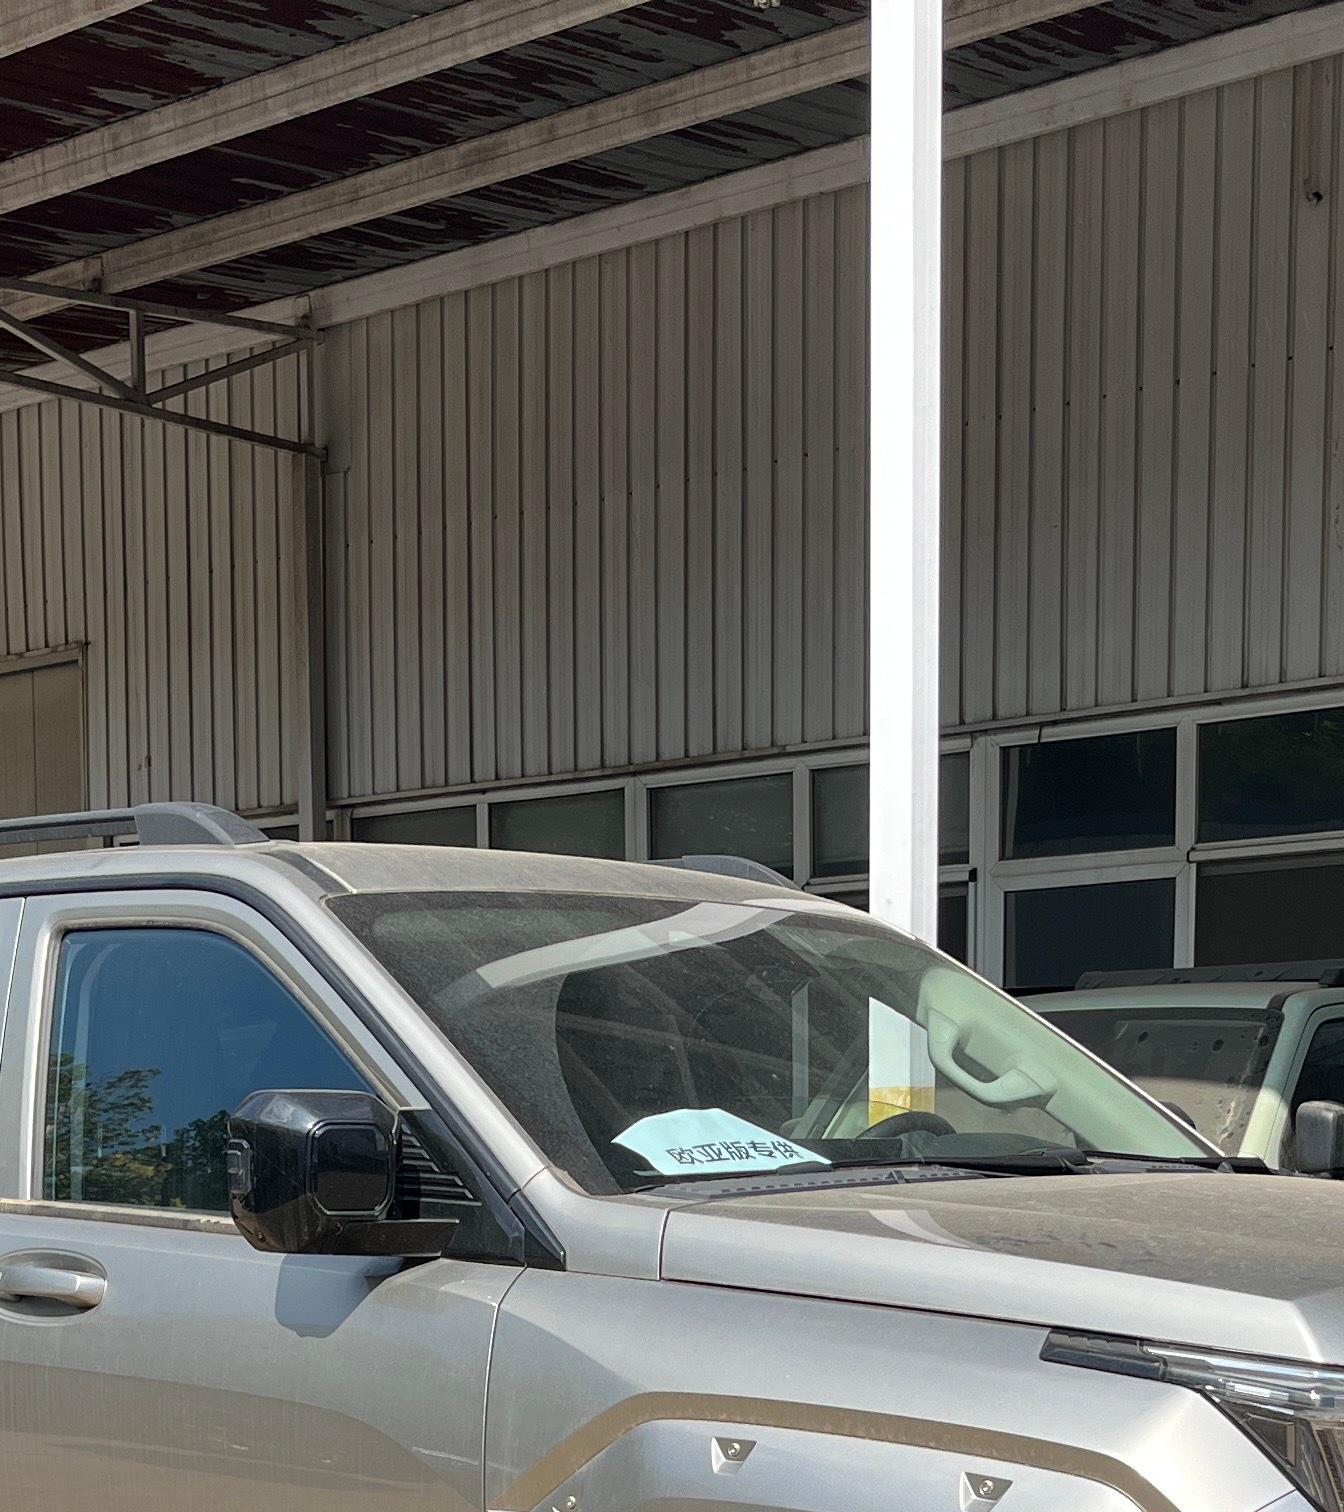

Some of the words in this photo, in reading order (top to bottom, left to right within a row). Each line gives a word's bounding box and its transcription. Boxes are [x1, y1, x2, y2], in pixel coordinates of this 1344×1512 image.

[665, 1141, 804, 1165] 欧亚版专供
